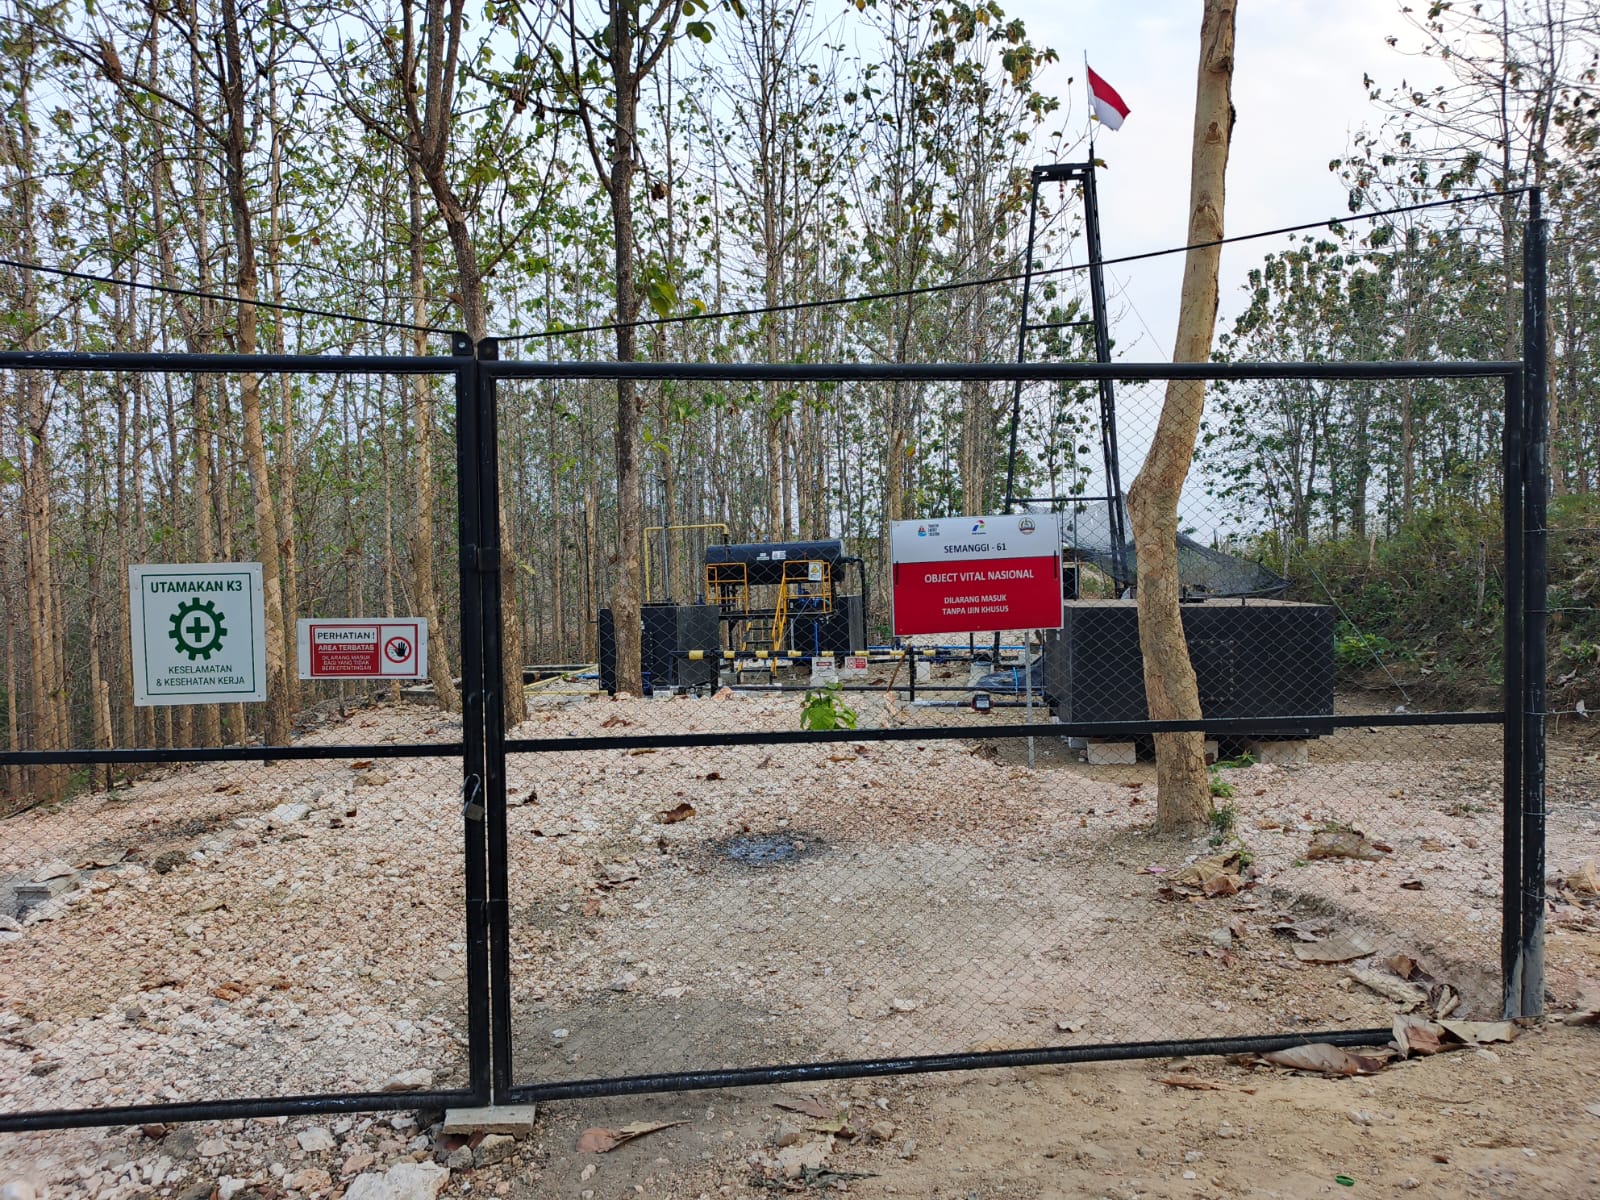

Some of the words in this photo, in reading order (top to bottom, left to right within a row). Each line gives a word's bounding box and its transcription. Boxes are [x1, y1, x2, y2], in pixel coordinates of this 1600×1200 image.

[944, 543, 990, 553] SEMANGGI
[996, 543, 1007, 551] 61
[924, 573, 958, 583] OBJECT
[959, 571, 985, 582] VITAL
[988, 569, 1035, 580] NASIONAL
[150, 581, 223, 593] UTAMAKAN
[227, 580, 242, 592] K3
[944, 595, 980, 604] DILARANG
[981, 594, 1007, 603] MASUK
[942, 607, 966, 616] TANPA
[981, 605, 1009, 614] KHUSUS
[317, 632, 370, 640] PERHATIAN
[168, 665, 232, 674] KESELAMATAN
[156, 678, 162, 687] &
[164, 677, 216, 686] KESEHATAN
[218, 676, 245, 685] KERJA
